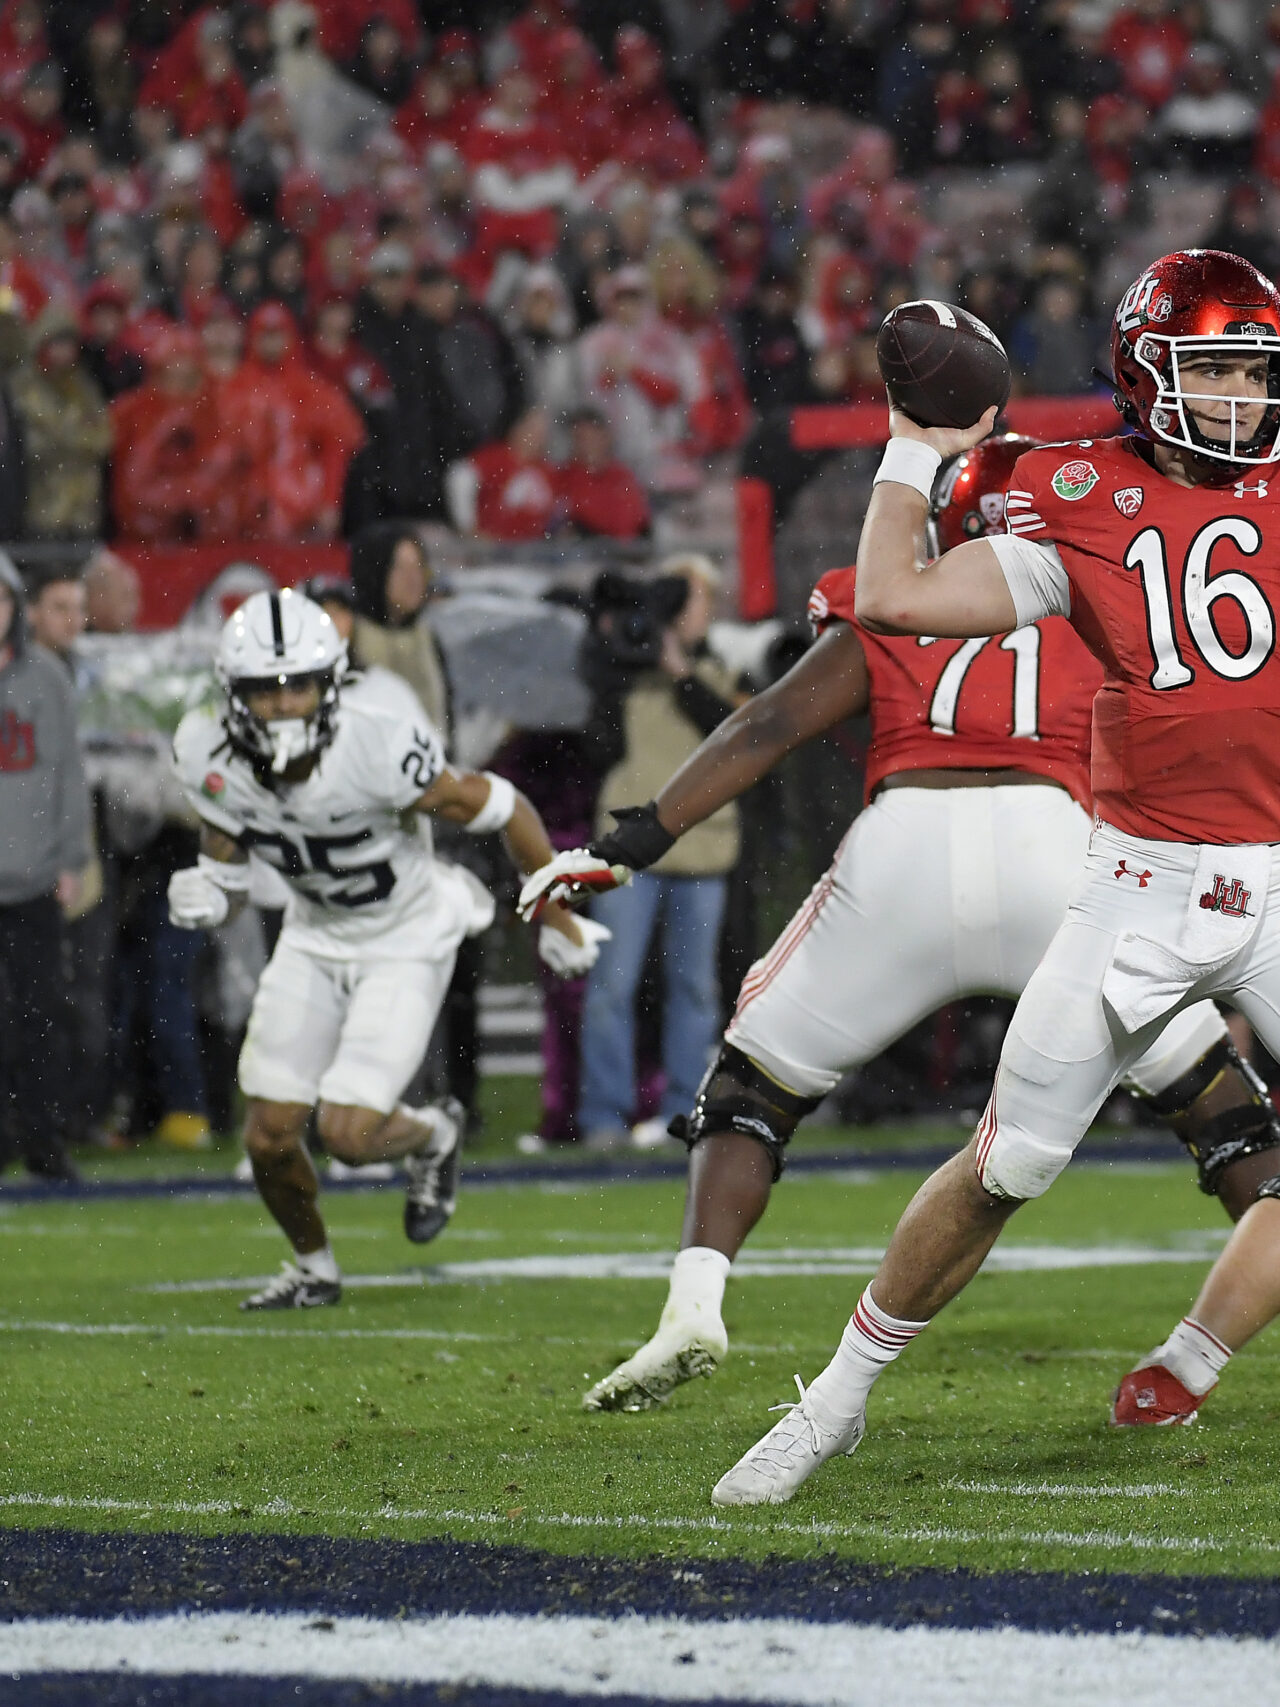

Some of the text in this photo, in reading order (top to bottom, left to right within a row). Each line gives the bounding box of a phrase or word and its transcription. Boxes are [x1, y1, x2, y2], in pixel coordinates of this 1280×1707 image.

[1114, 488, 1143, 506] PAC
[1123, 502, 1140, 515] 12
[1123, 514, 1277, 692] 16
[916, 623, 1042, 742] 71
